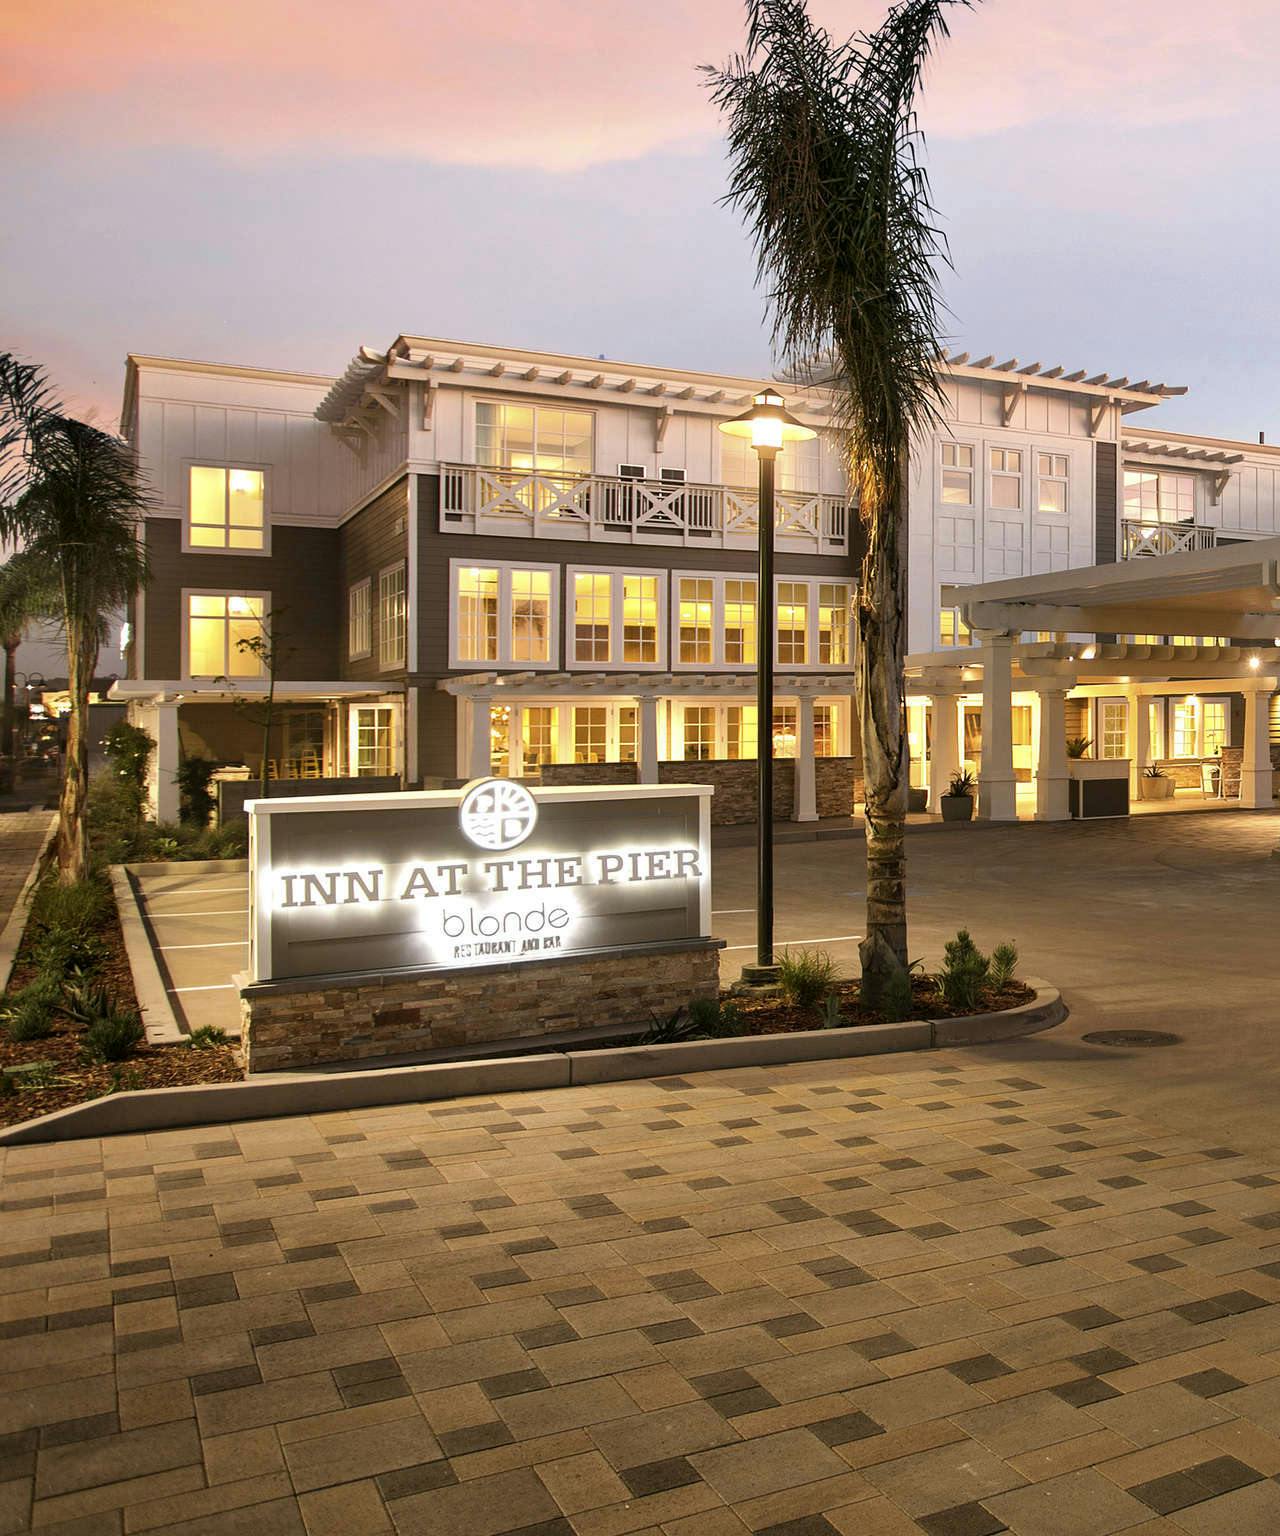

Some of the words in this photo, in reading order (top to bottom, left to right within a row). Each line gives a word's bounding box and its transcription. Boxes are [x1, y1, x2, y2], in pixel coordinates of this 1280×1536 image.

[281, 869, 384, 908] INN
[400, 863, 468, 900] AT
[484, 856, 583, 892] THE
[597, 849, 703, 884] PIER
[442, 902, 570, 938] blonde
[453, 940, 517, 959] RESTAURANT
